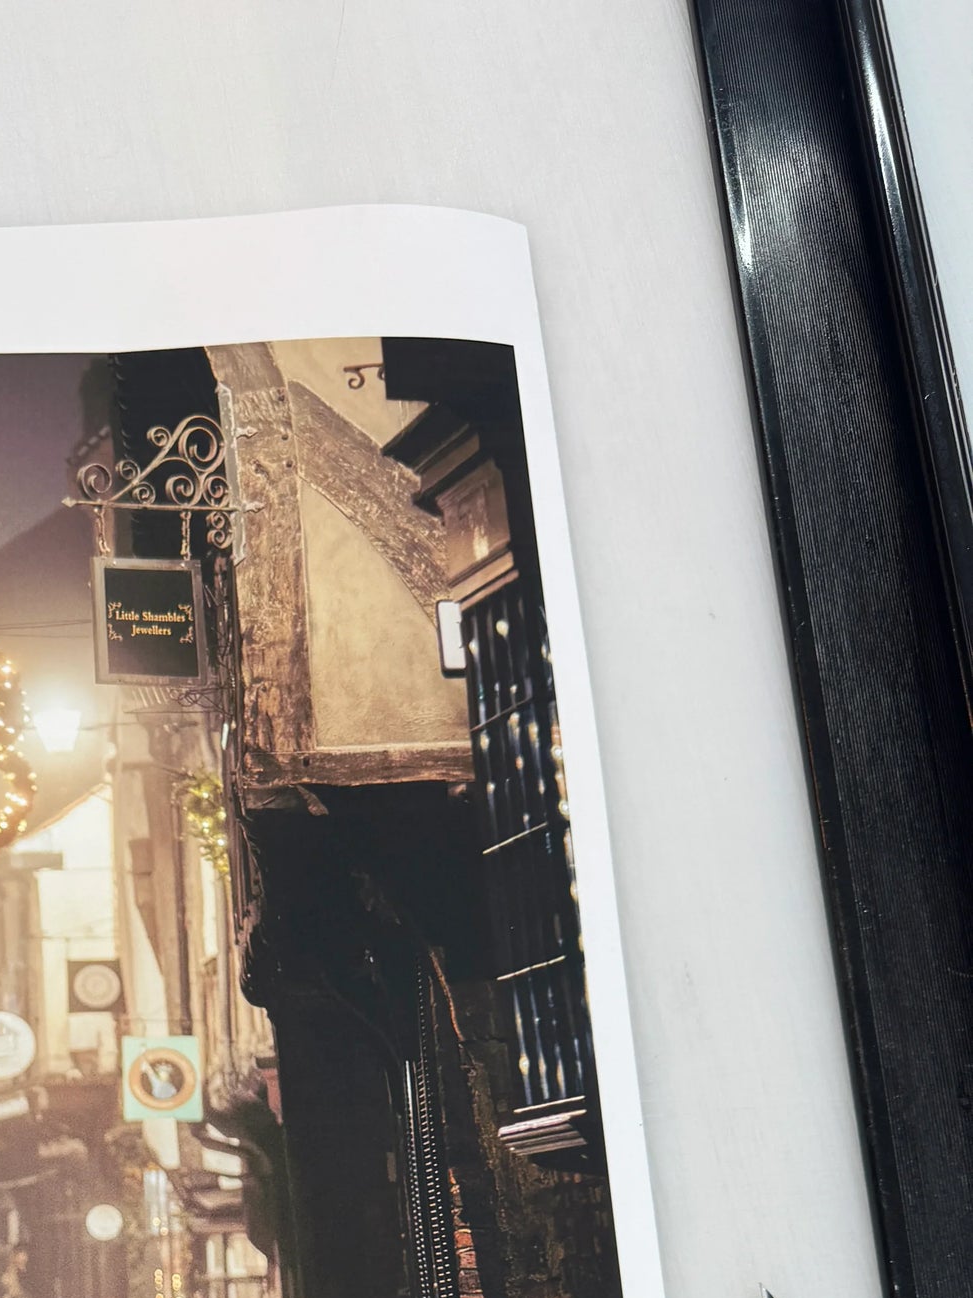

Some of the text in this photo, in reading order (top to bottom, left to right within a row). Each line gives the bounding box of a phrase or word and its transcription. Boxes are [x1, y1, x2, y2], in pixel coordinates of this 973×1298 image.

[115, 611, 186, 622] Little Shambles
[131, 625, 172, 637] Jewellers
